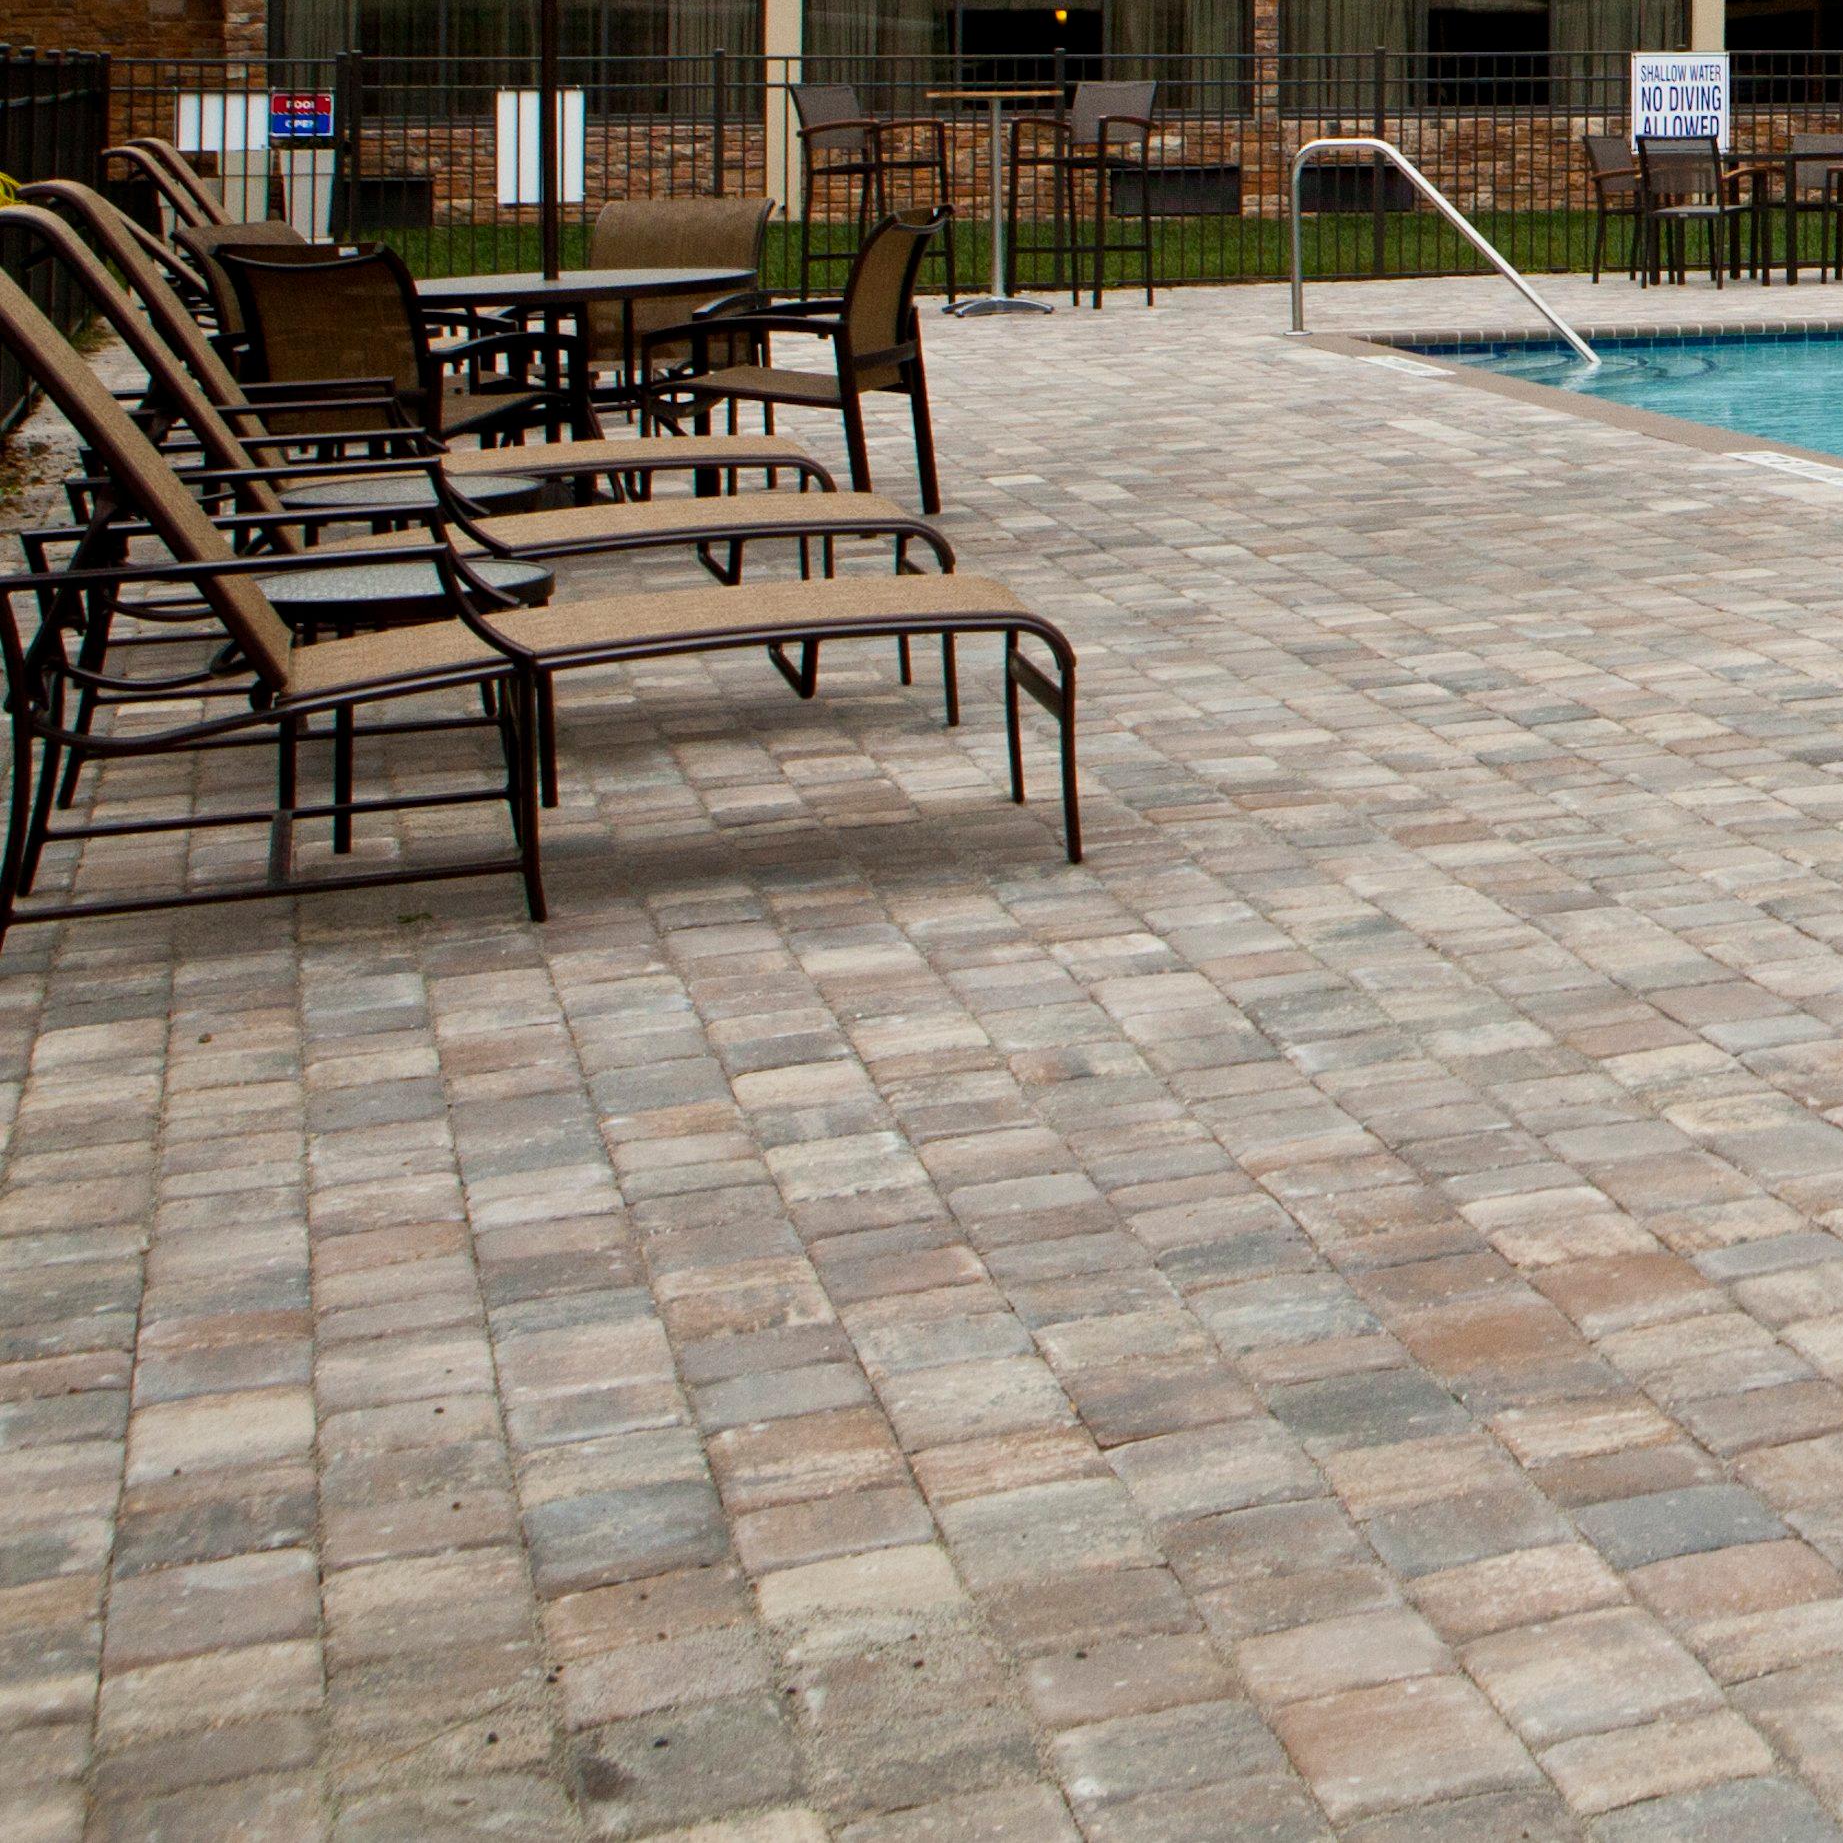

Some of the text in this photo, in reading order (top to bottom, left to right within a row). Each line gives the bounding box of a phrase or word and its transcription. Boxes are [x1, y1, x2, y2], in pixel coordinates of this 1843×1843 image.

[1641, 65, 1721, 82] SHALLOW WATER
[1641, 86, 1722, 112] NO DIVING
[1643, 115, 1719, 136] ALLOWED
